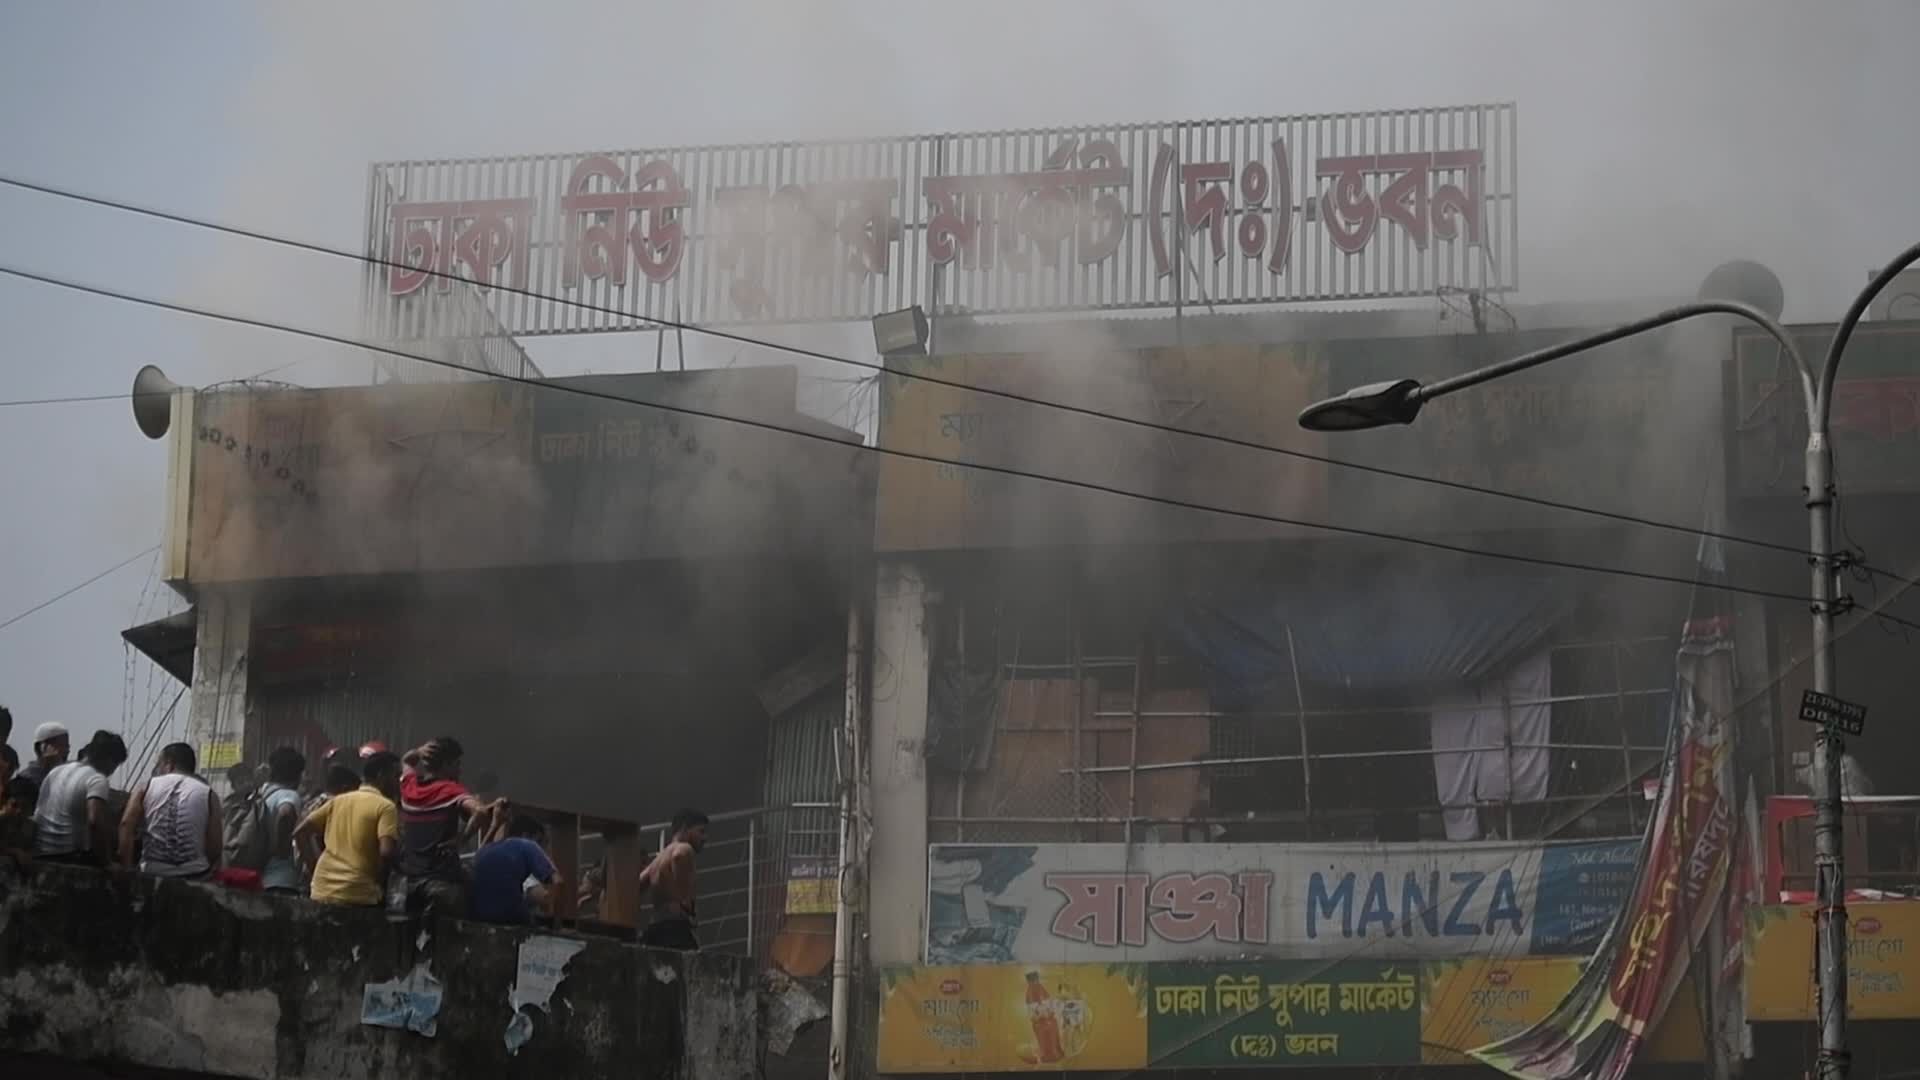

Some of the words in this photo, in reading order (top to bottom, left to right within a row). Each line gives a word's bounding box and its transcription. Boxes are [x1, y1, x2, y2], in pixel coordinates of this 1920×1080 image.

[391, 196, 536, 296] ঢাকা
[562, 156, 690, 288] নিউ
[922, 138, 1130, 271] মার্কেট
[1316, 148, 1487, 253] ভবন
[1044, 869, 1275, 948] মাঞ্জা
[1306, 868, 1524, 938] MANZA
[1155, 985, 1207, 1016] ঢাকা
[1214, 974, 1260, 1015] নিউ
[1268, 983, 1331, 1029] সুপার
[1339, 966, 1416, 1014] মার্কেট
[1230, 1034, 1277, 1057] (দঃ)
[1284, 1033, 1339, 1057] ভবন
